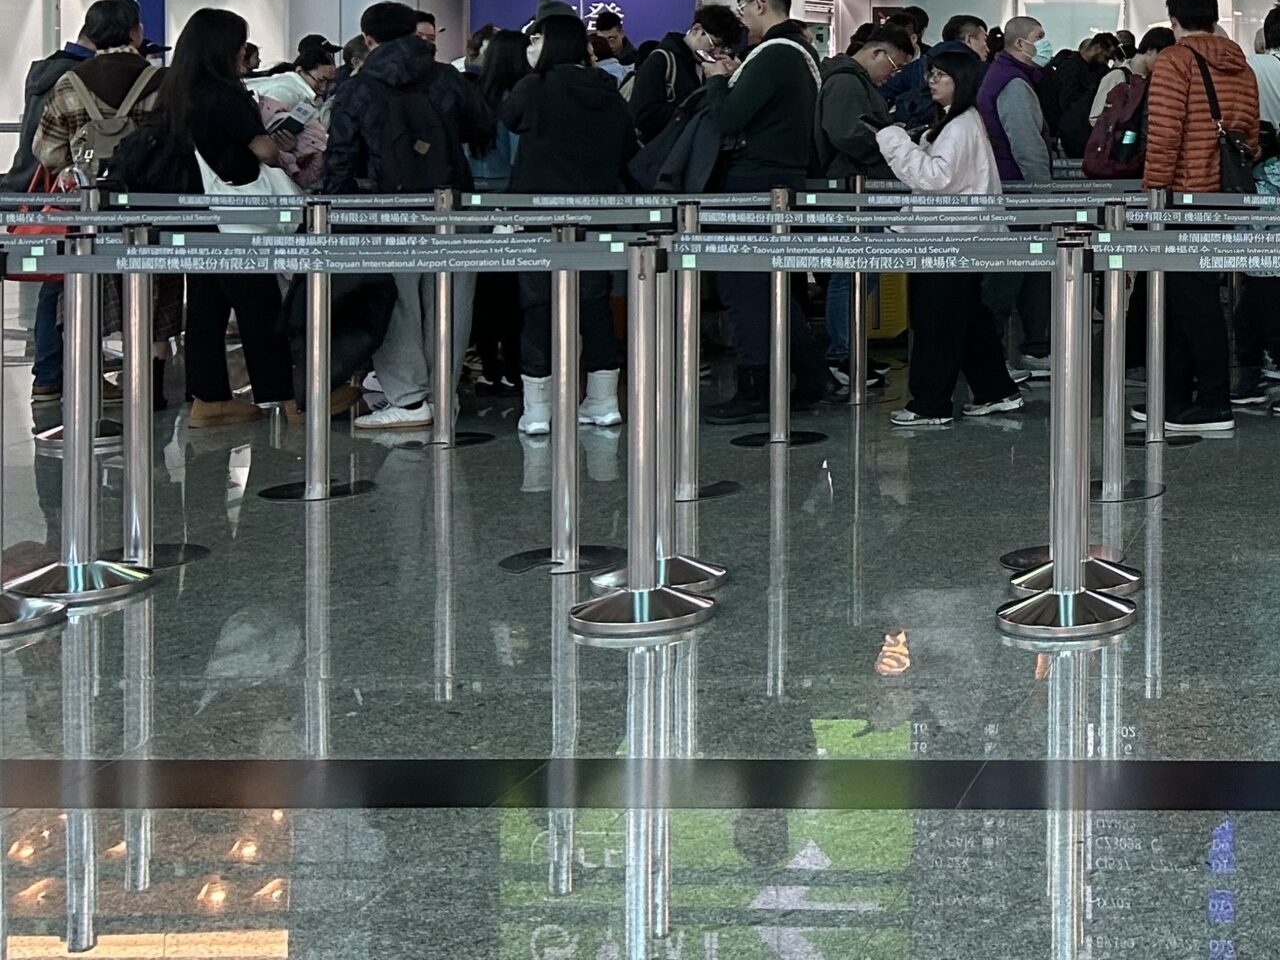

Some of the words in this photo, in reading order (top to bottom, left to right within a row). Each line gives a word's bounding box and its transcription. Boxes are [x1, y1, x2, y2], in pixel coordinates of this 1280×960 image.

[273, 257, 324, 271] 機場保全
[326, 259, 361, 268] Taoyuan
[362, 259, 415, 268] International
[416, 258, 447, 268] Airport
[448, 257, 500, 268] Corporation
[501, 257, 516, 266] Ltd
[516, 256, 551, 268] Security
[921, 256, 970, 269] 機場保全
[971, 258, 1005, 268] Taoyuan
[1006, 258, 1055, 267] Internationa
